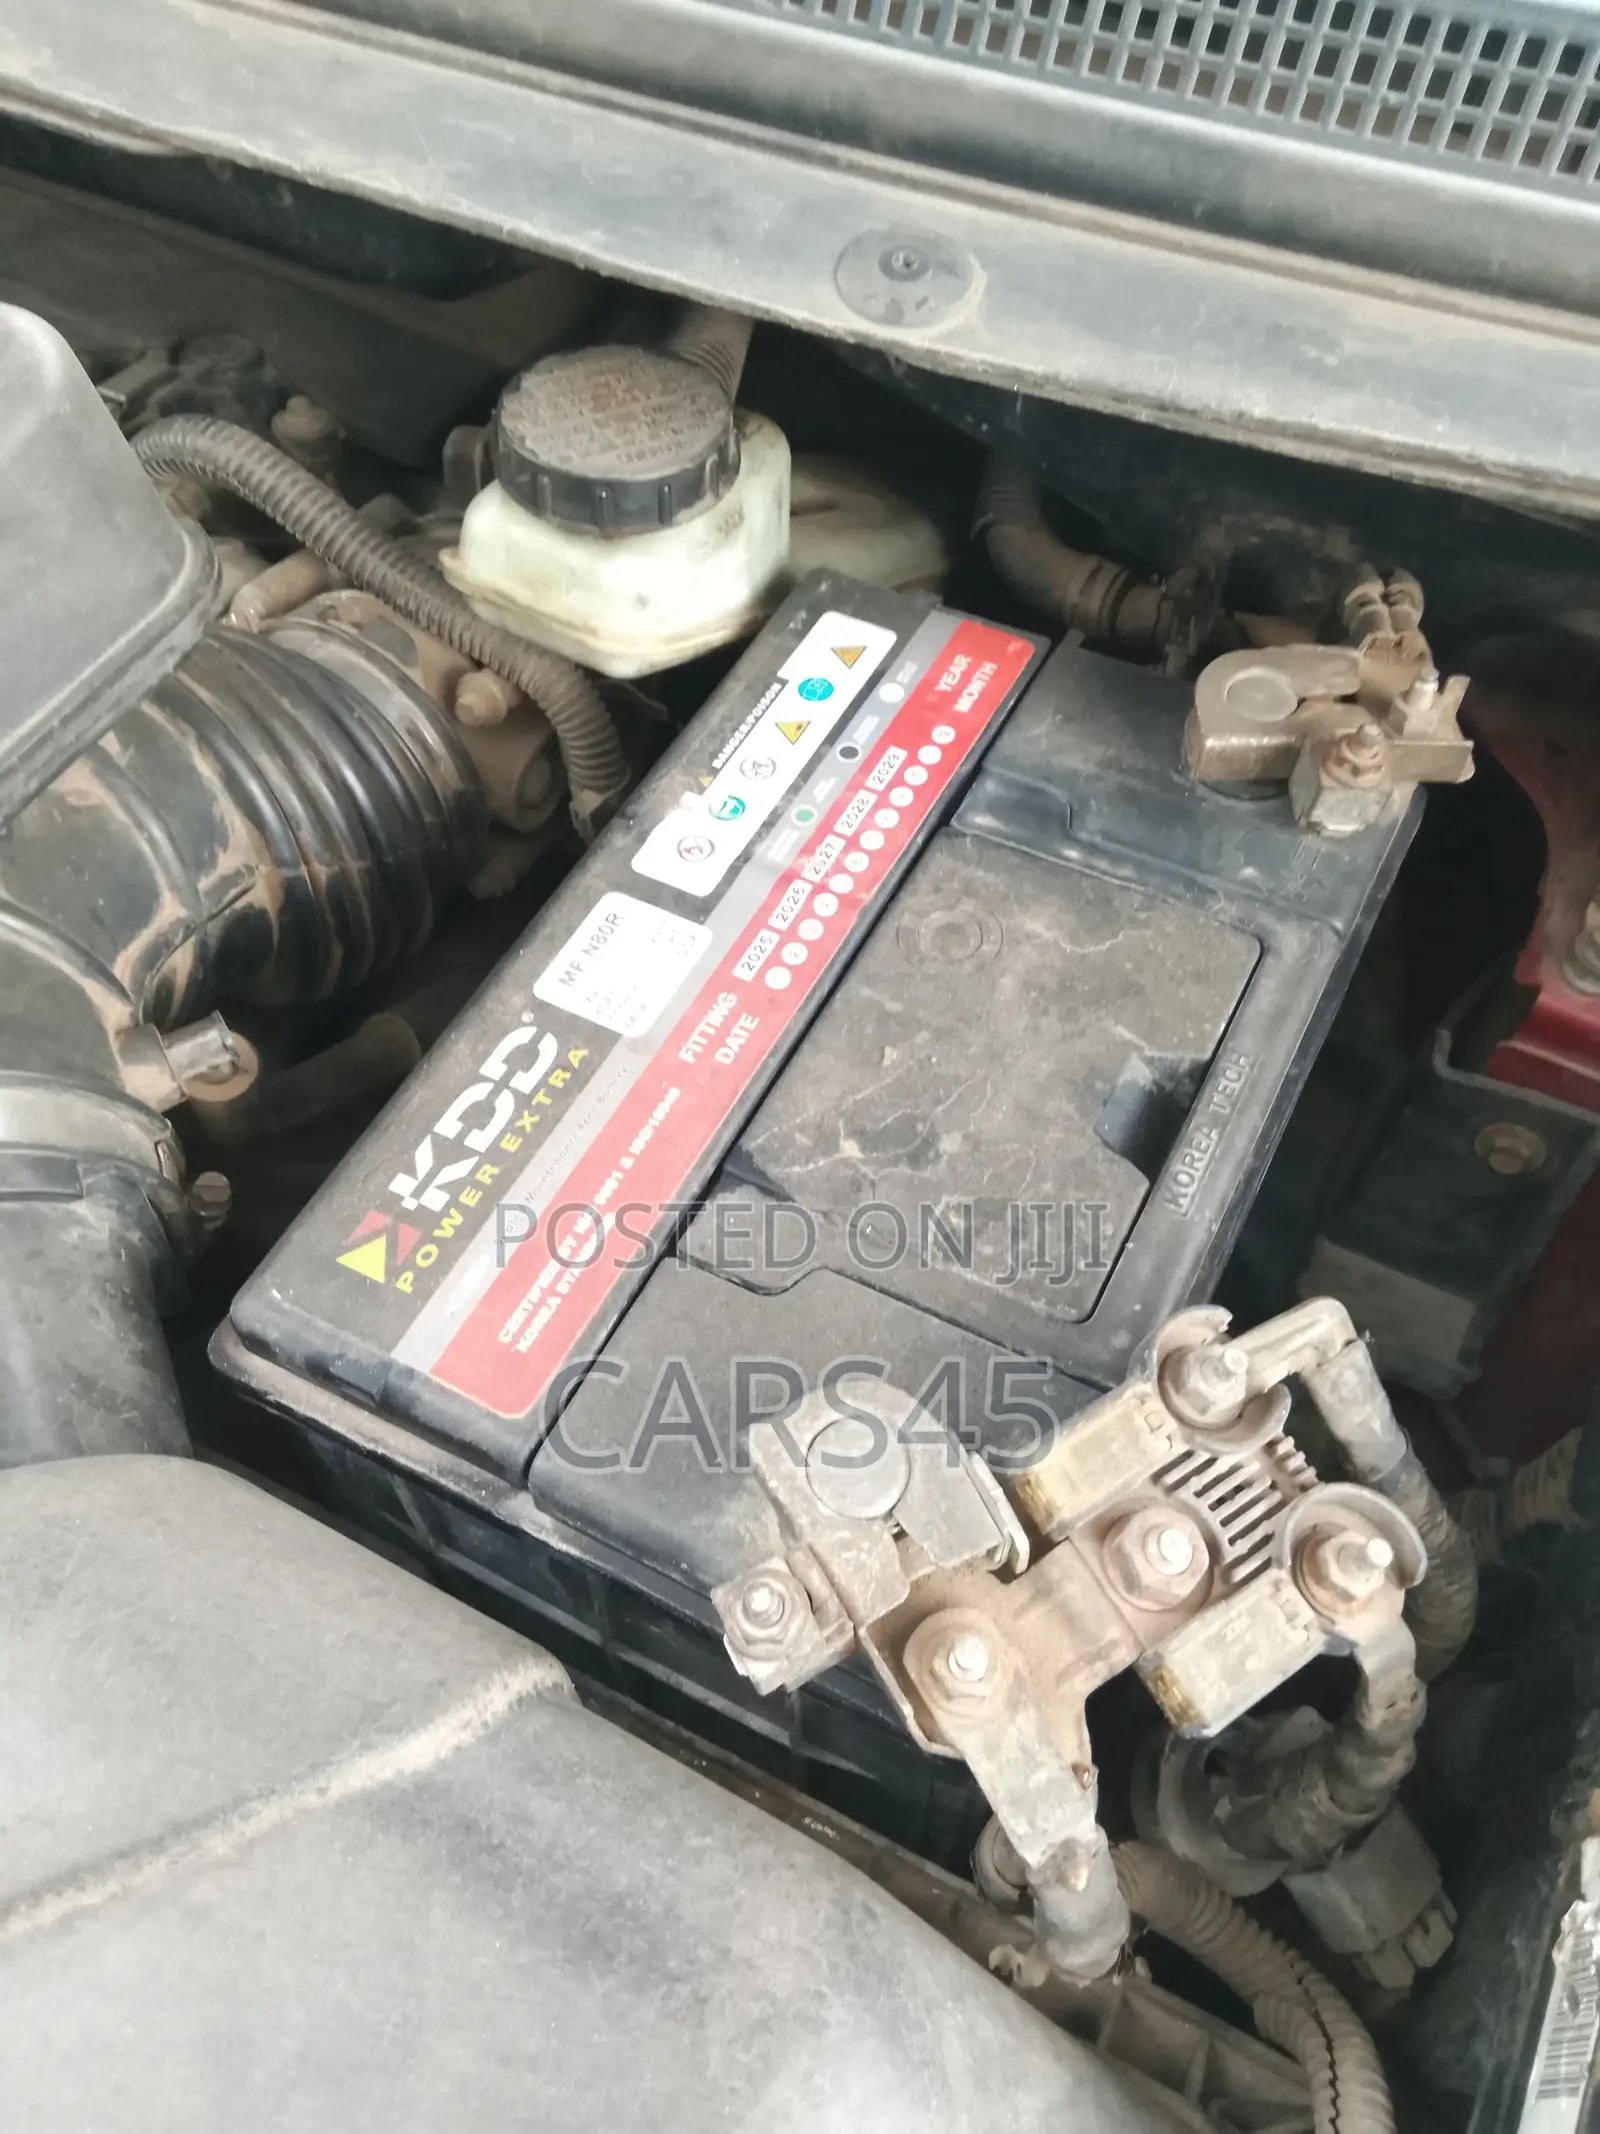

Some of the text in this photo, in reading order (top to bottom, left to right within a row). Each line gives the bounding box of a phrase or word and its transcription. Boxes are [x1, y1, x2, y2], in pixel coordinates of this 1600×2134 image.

[934, 653, 973, 691] YEAR
[952, 660, 999, 713] MONTH
[557, 958, 583, 987] MF
[579, 911, 625, 956] N80R
[740, 935, 773, 971] 2025
[678, 990, 738, 1064] FITTING
[714, 1012, 760, 1065] DATE
[387, 1029, 559, 1213] KDD
[1164, 1046, 1254, 1217] KOREA TECH
[394, 1049, 590, 1293] POWER EXTRA
